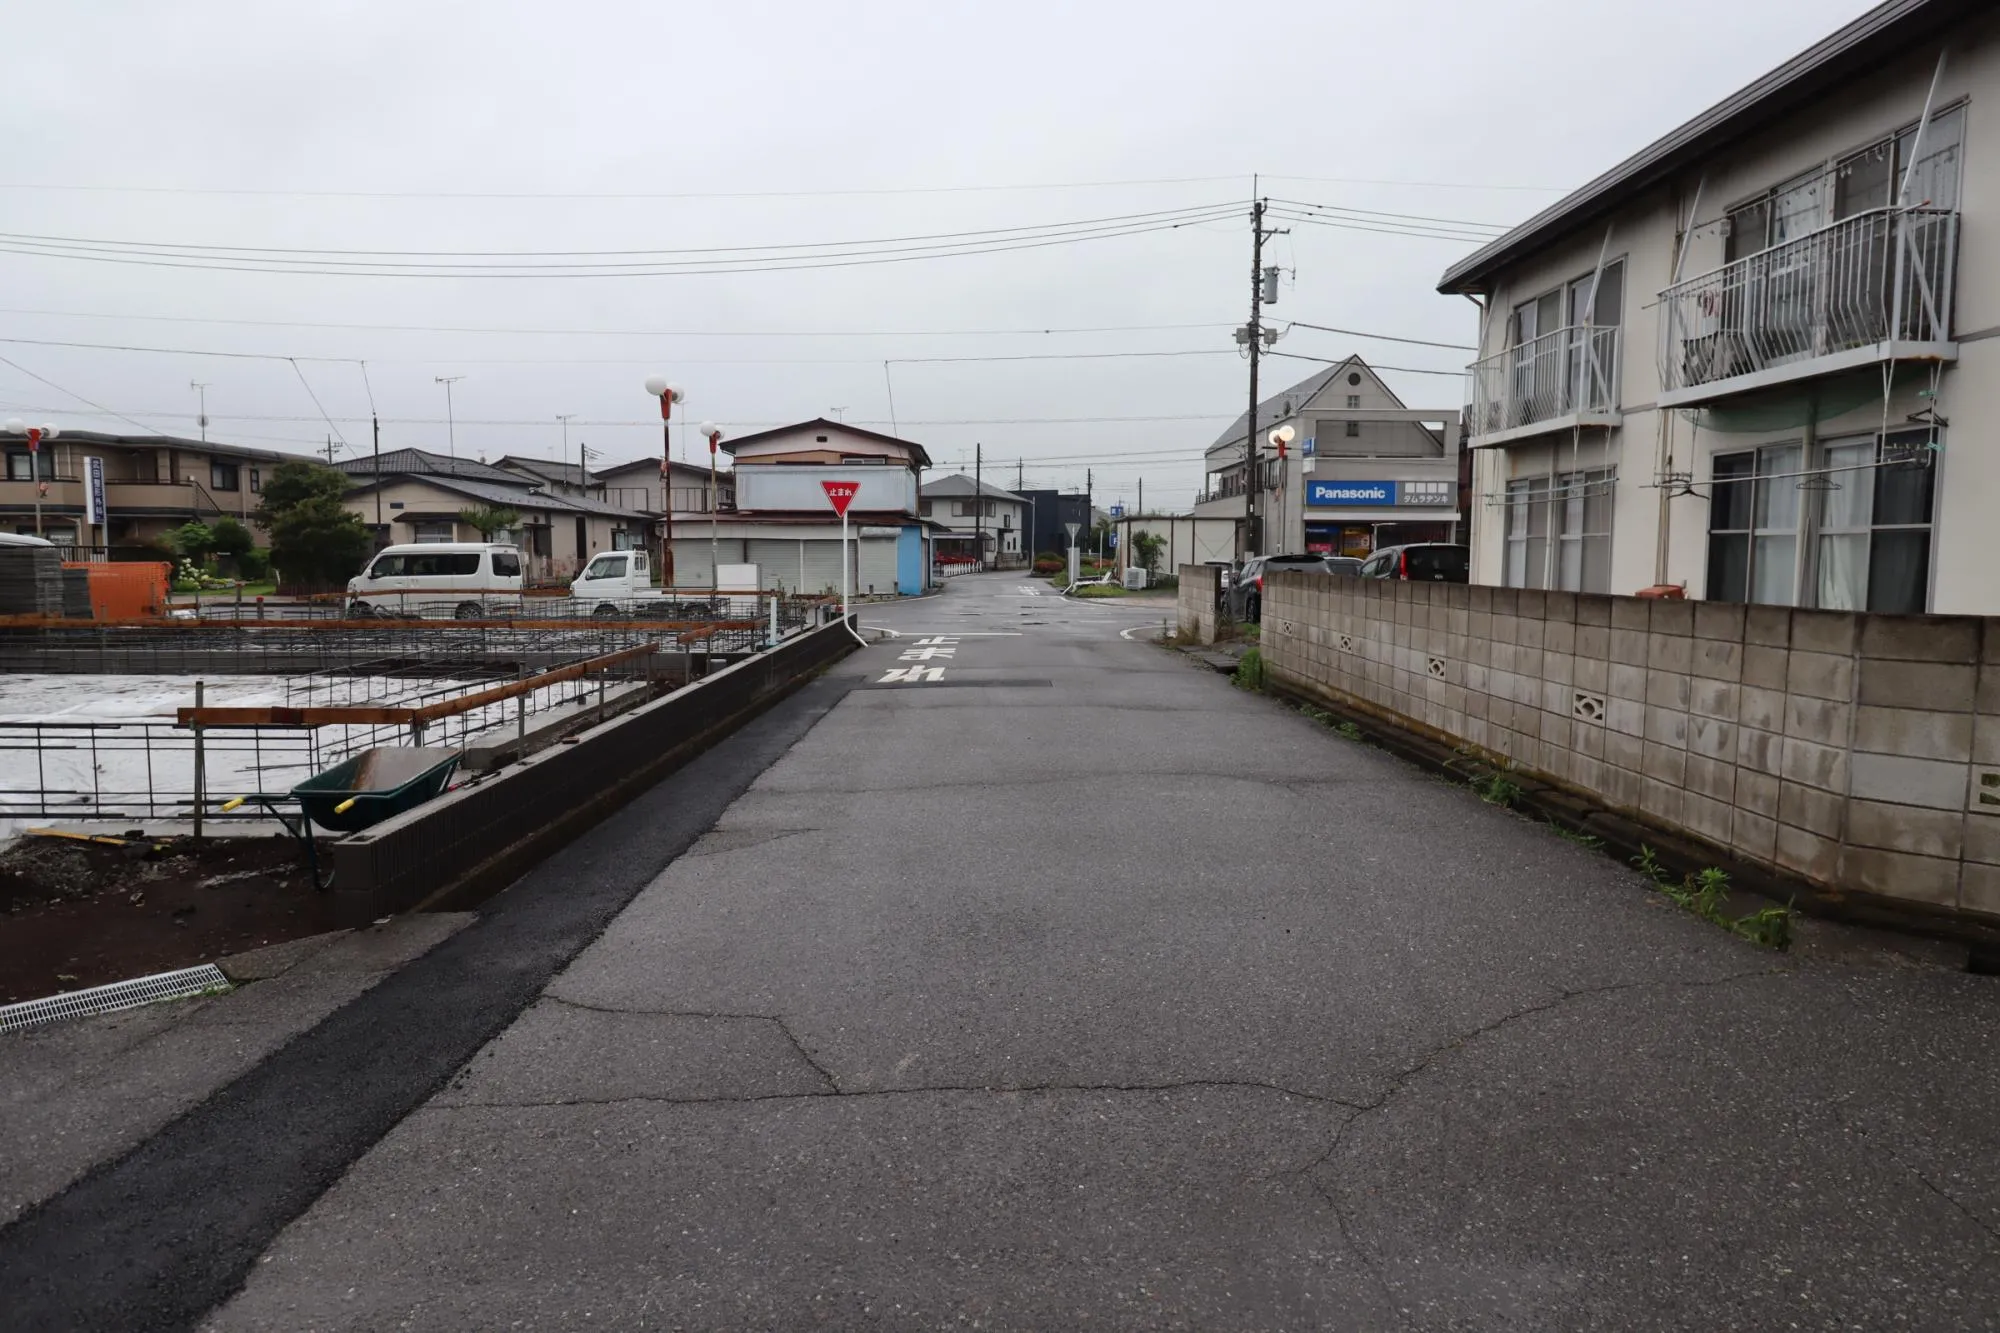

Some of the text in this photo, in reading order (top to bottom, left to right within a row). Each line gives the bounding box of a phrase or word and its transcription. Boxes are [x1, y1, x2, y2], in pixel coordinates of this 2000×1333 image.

[829, 487, 853, 497] 止まれ
[1315, 486, 1386, 499] Panasonic
[876, 636, 961, 683] 止まれ
